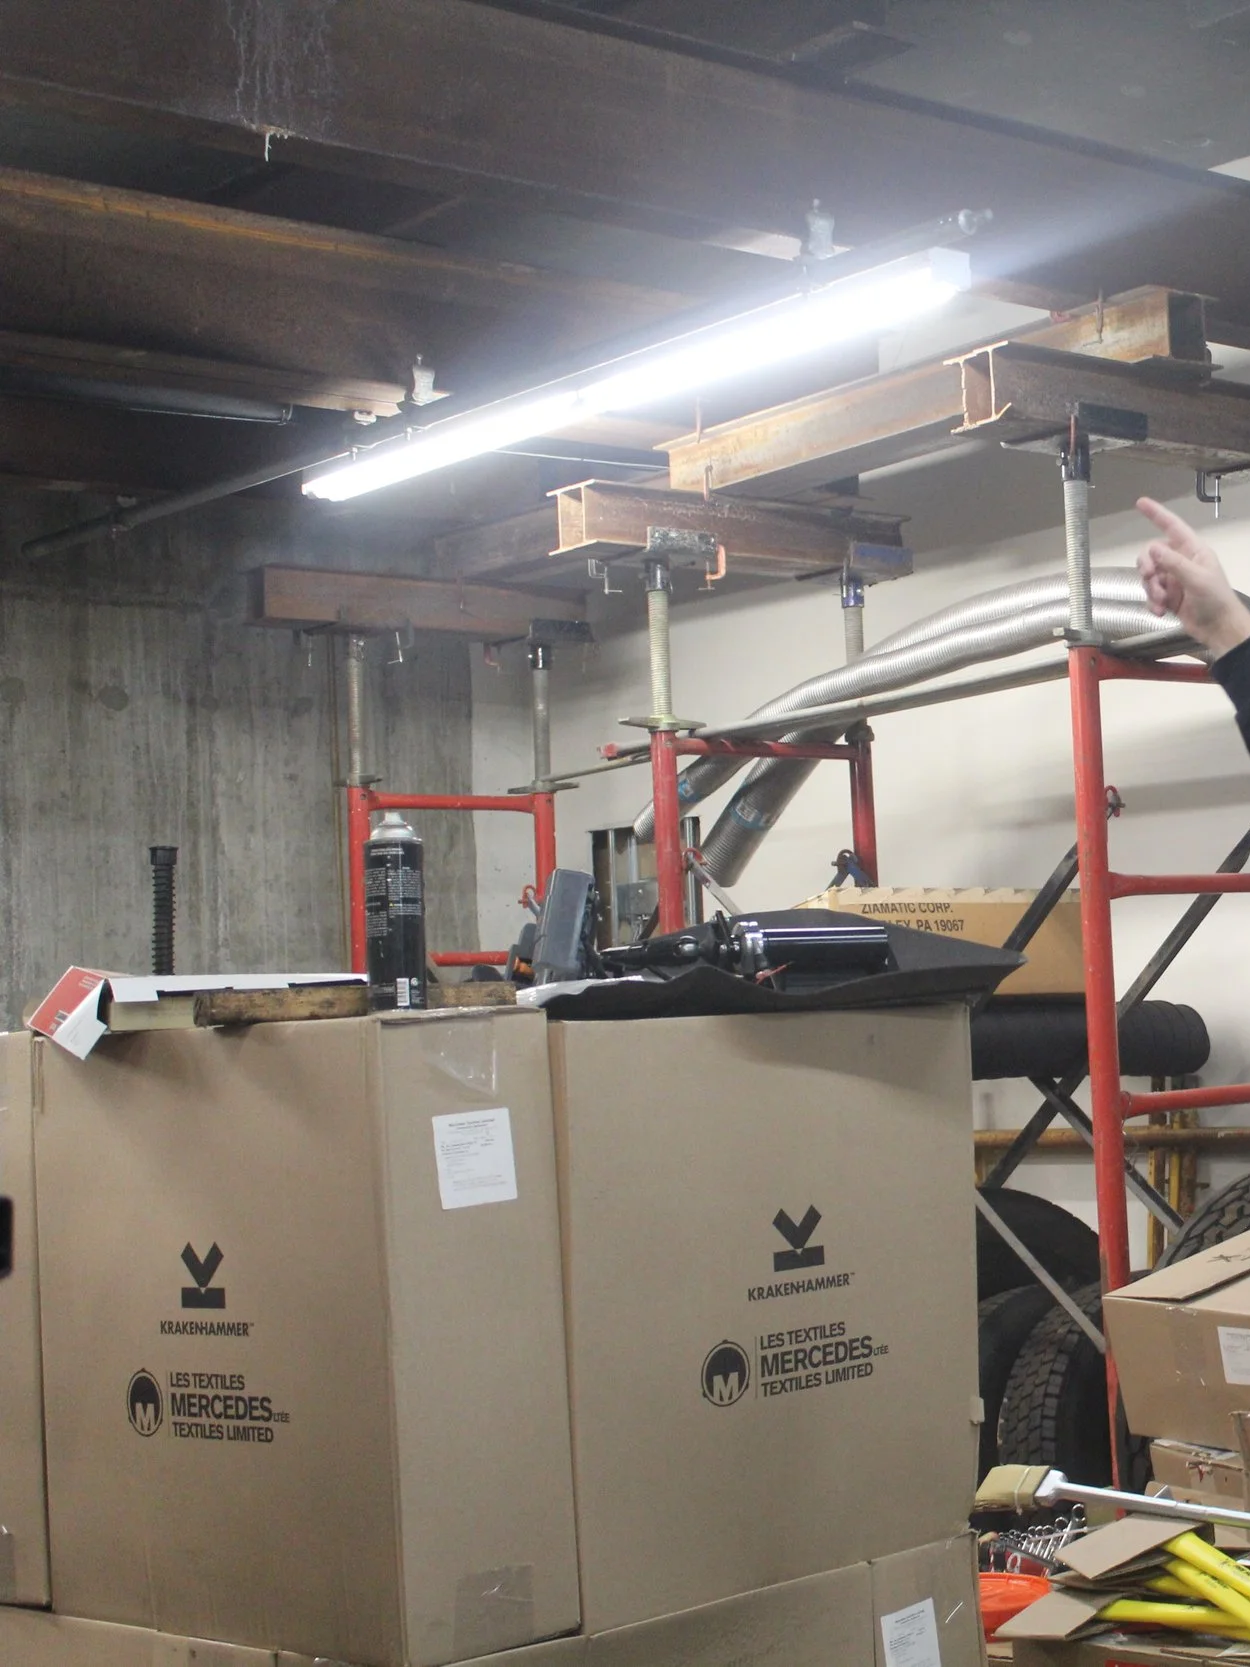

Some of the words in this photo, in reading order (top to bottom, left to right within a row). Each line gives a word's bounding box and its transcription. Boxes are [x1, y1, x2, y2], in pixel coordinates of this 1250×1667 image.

[862, 902, 916, 914] ZIAMATIC
[934, 919, 964, 932] 19067
[759, 1332, 785, 1350] LES
[786, 1321, 846, 1348] TEXTILES
[759, 1335, 873, 1378] MERCEDES
[170, 1372, 190, 1388] LES
[191, 1373, 245, 1391] TEXTILES
[761, 1371, 822, 1397] TEXTILES
[825, 1362, 873, 1385] LIMITED
[171, 1392, 272, 1422] MERCEDES
[172, 1421, 224, 1440] TEXTILES
[226, 1424, 274, 1443] LIMITED
